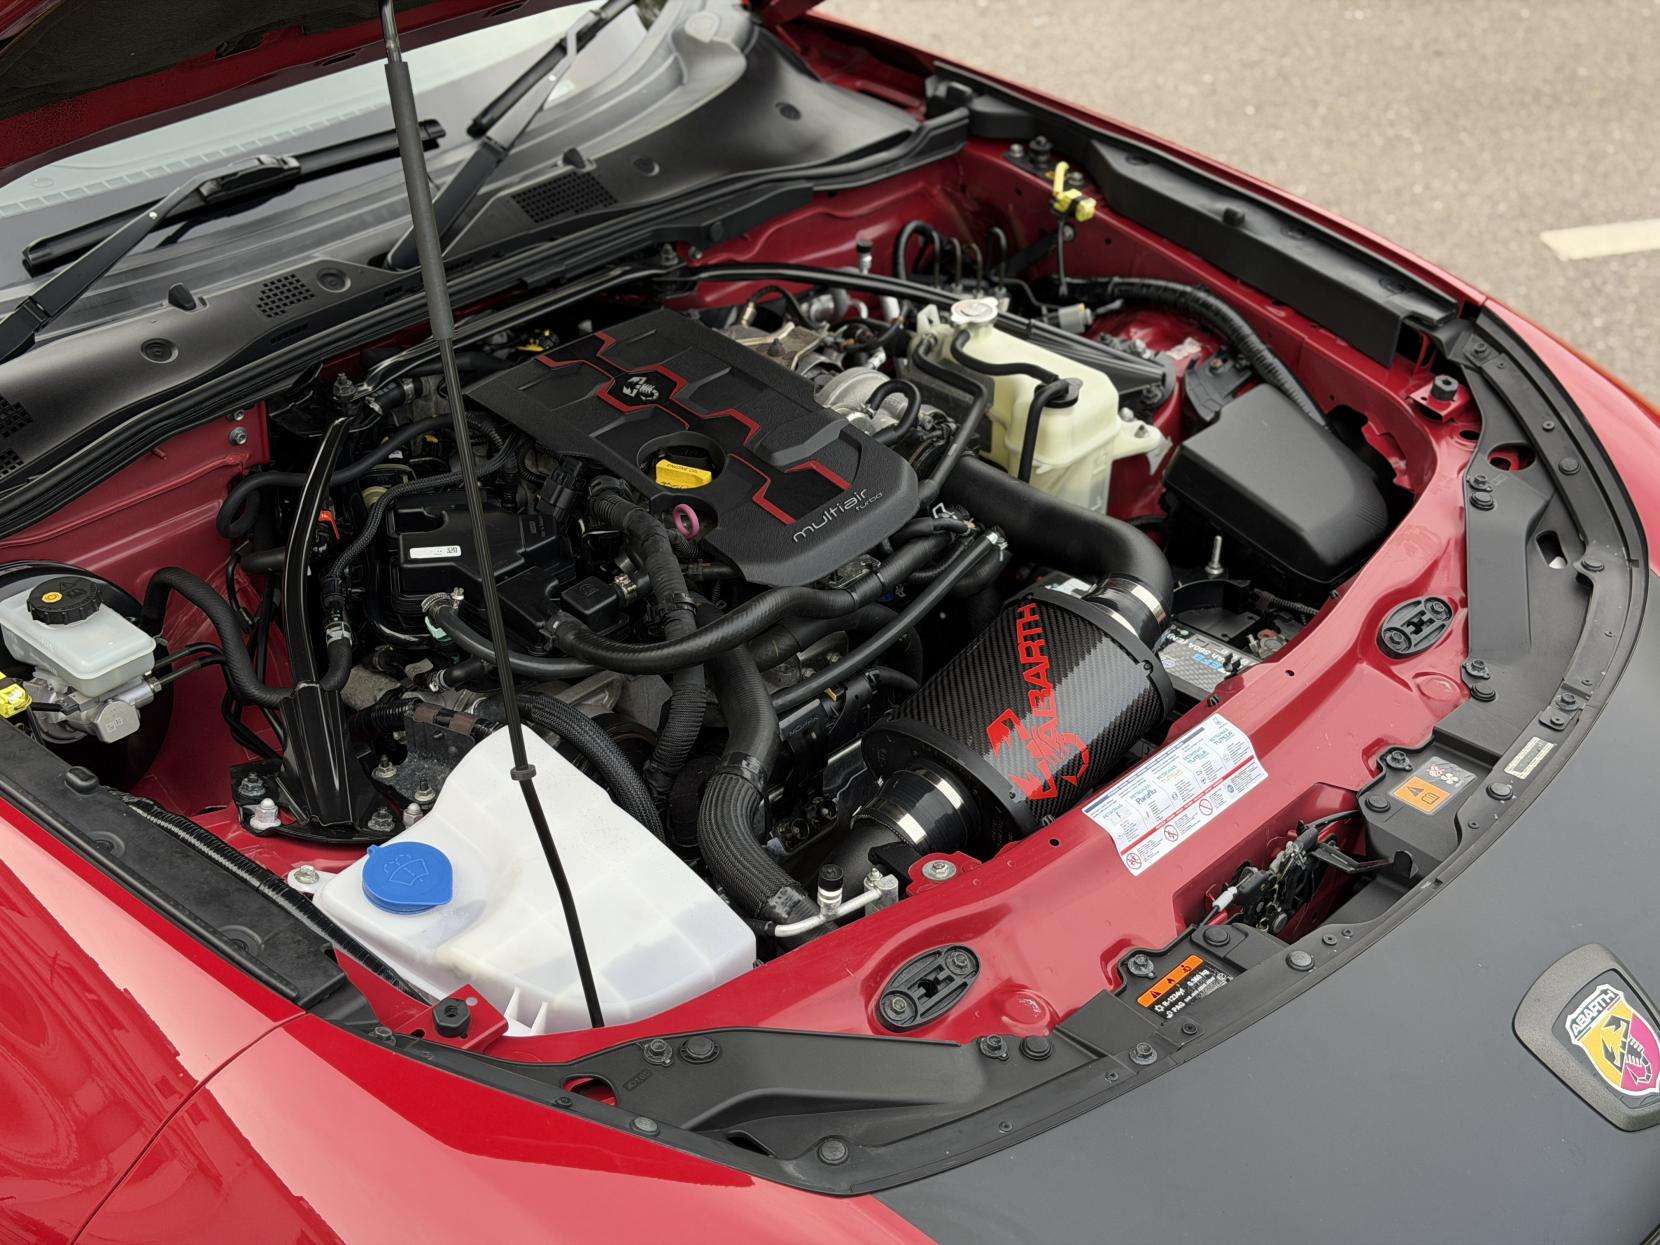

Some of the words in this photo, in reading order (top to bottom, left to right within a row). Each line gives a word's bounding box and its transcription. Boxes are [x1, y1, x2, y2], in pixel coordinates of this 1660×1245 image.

[793, 489, 867, 542] multiair
[855, 492, 883, 511] turbo
[1016, 602, 1059, 742] ABARTH
[1135, 789, 1157, 805] Paraflu
[1171, 1001, 1186, 1013] PAG
[1571, 989, 1615, 1036] ABARTH
